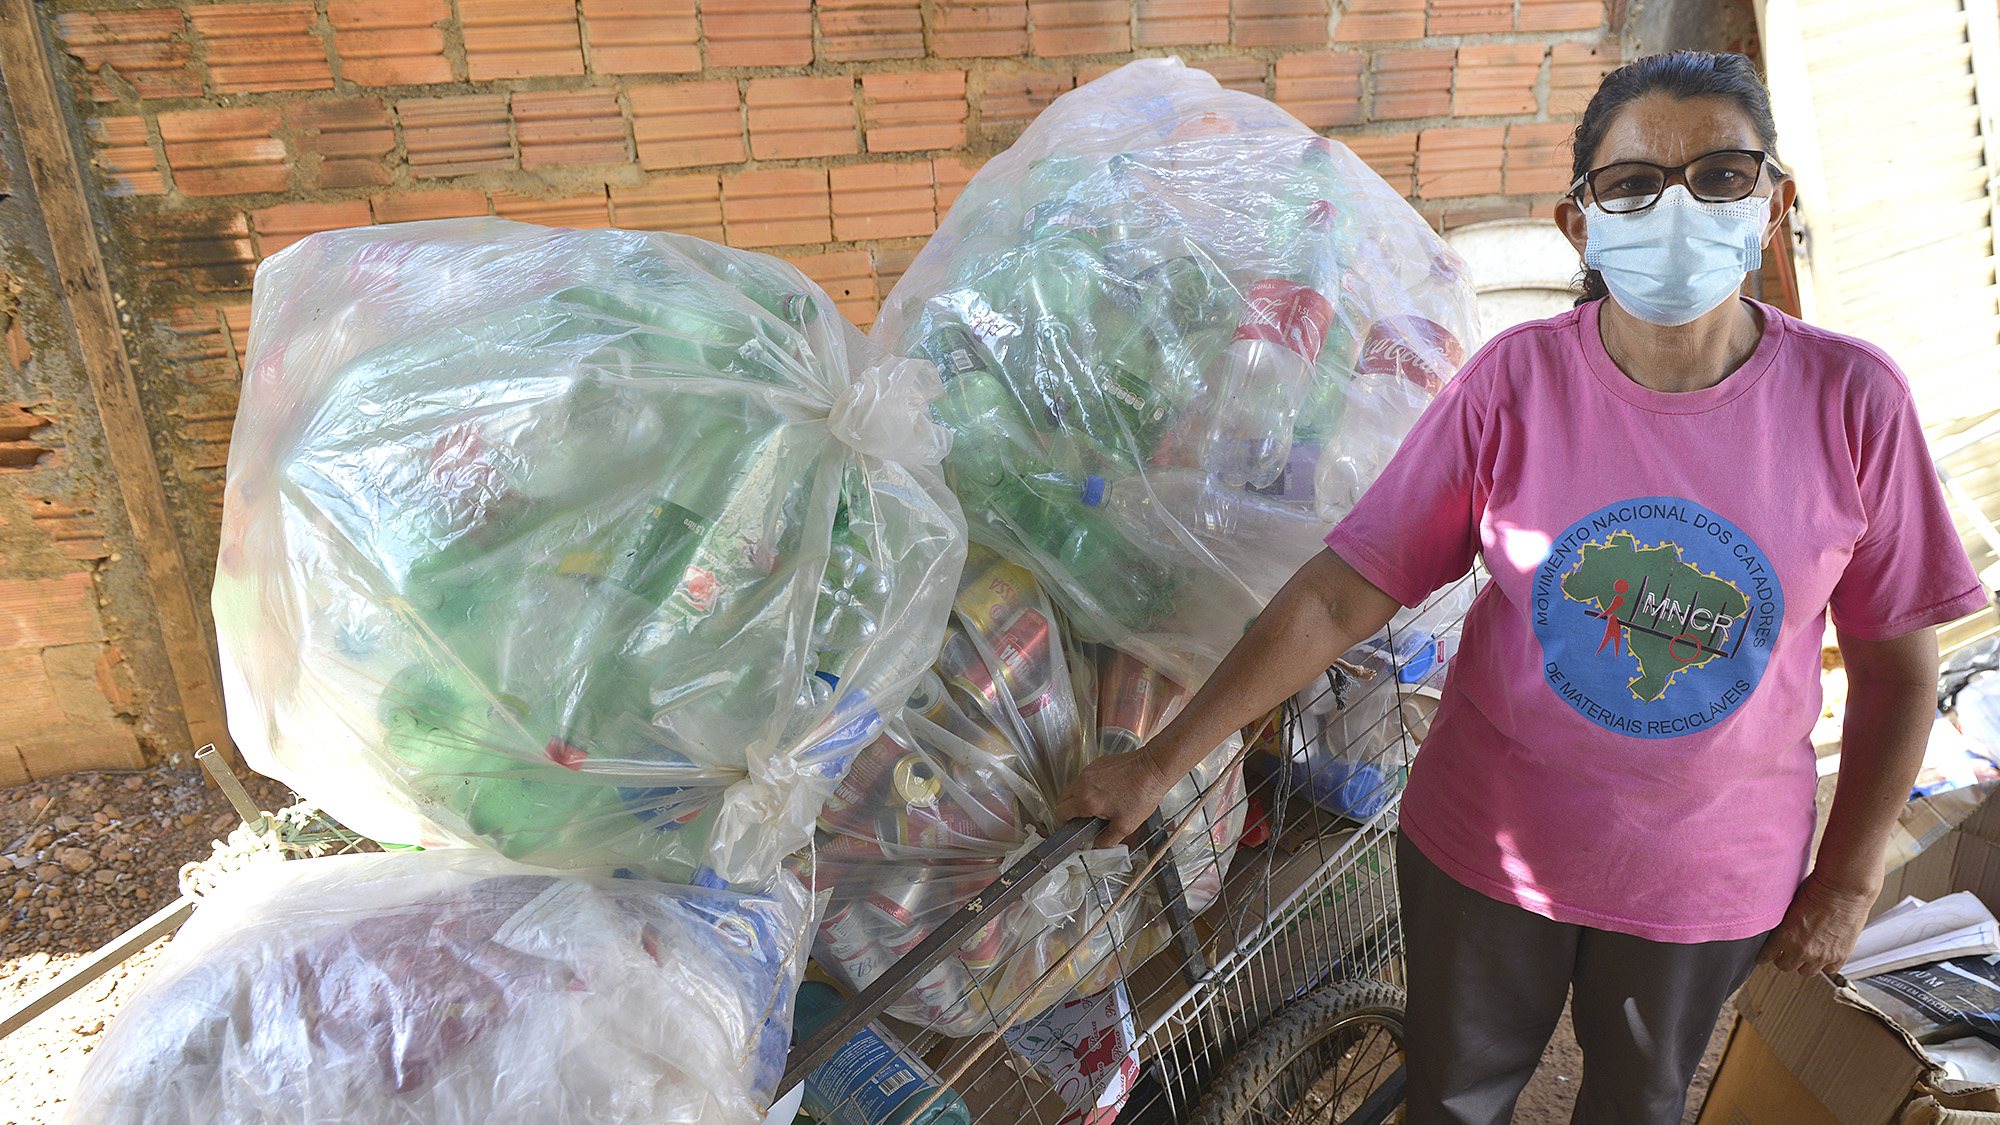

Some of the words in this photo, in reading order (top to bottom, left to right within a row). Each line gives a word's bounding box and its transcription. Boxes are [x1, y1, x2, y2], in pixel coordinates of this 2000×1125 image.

[1536, 527, 1590, 626] MOVIMENTO
[1592, 504, 1688, 529] NACIONAL
[1693, 513, 1733, 545] DOS
[1732, 543, 1775, 649] CATADORES
[1641, 591, 1736, 639] MNCR
[1545, 660, 1566, 685] DE
[1559, 680, 1643, 735] MATERIAIS
[1647, 678, 1751, 735] RECICLÁVEIS
